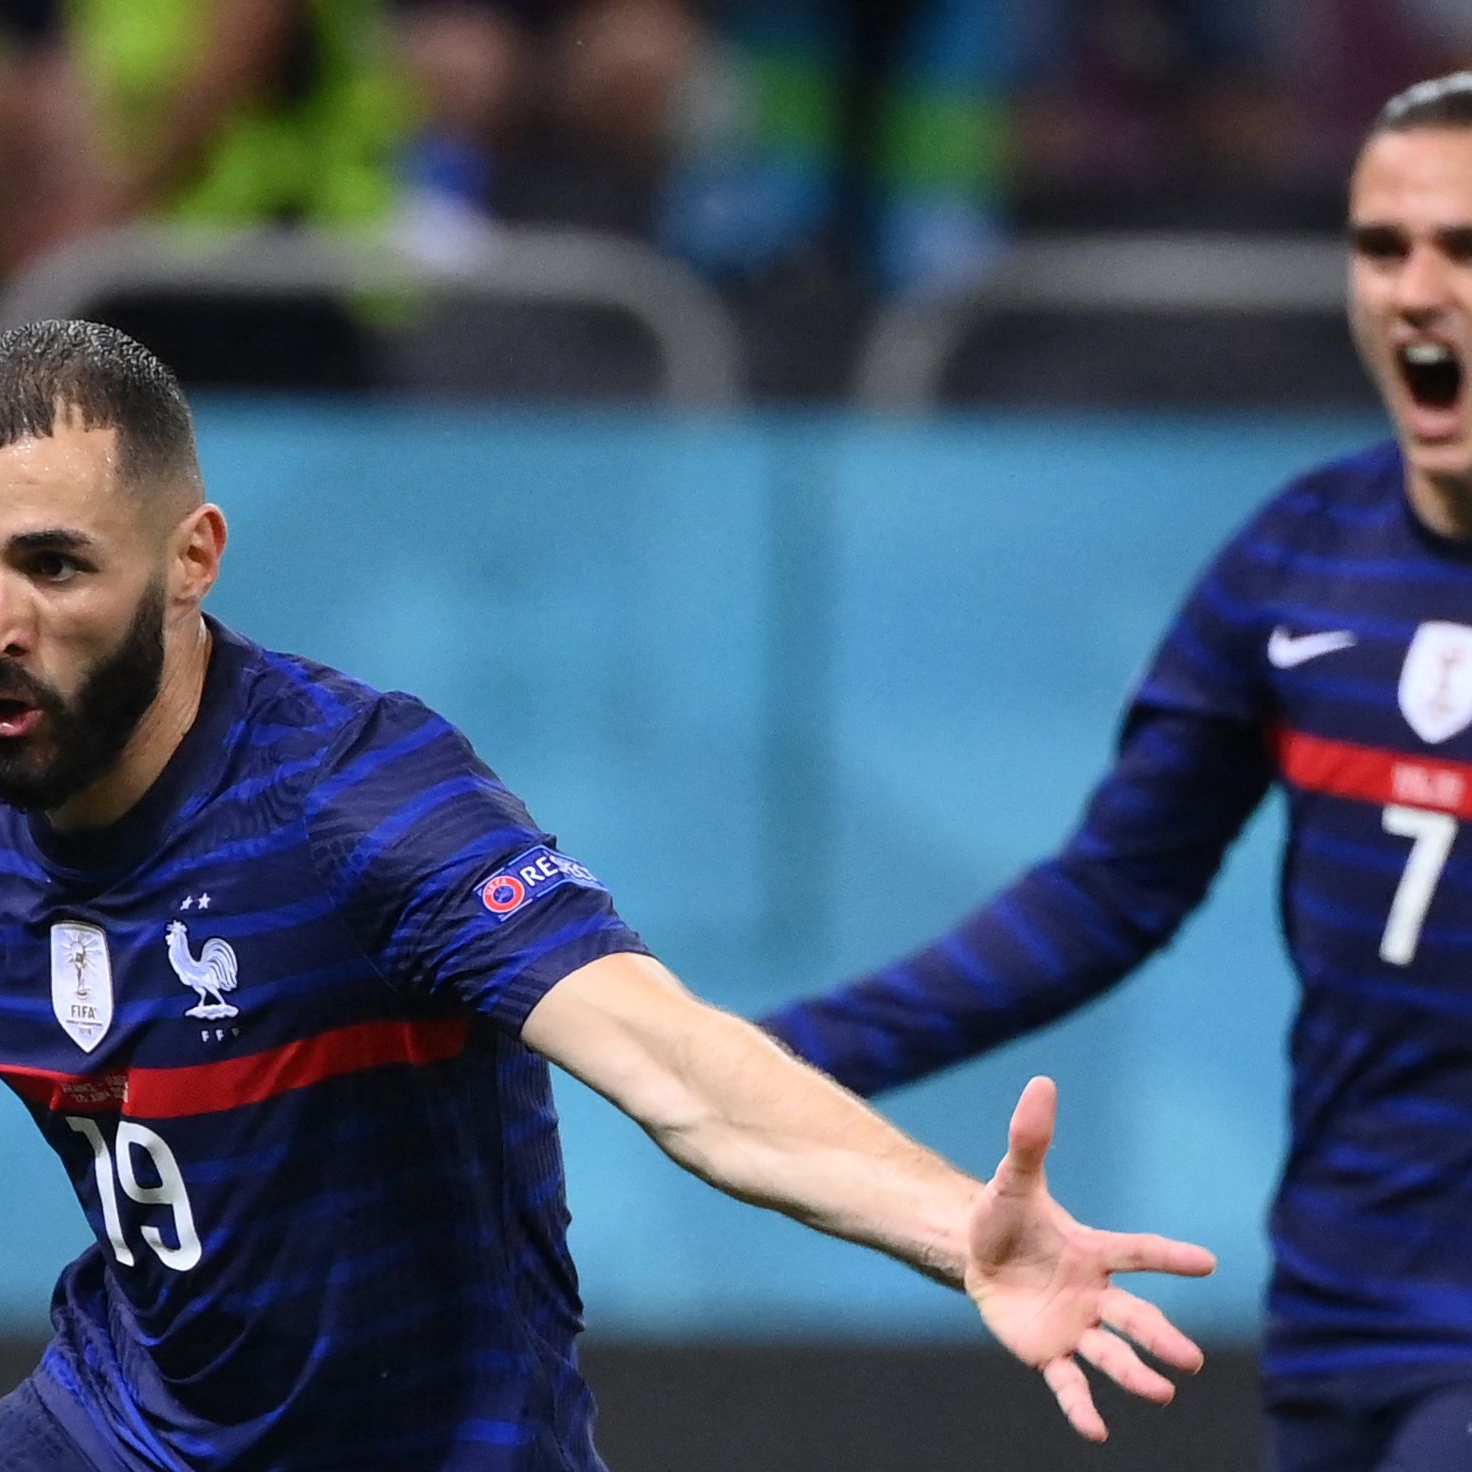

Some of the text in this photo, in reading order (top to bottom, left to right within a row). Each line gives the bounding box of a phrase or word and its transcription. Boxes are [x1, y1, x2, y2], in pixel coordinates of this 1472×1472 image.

[1380, 804, 1459, 967] 7
[70, 1004, 96, 1020] FIFA
[65, 1116, 202, 1271] 19
